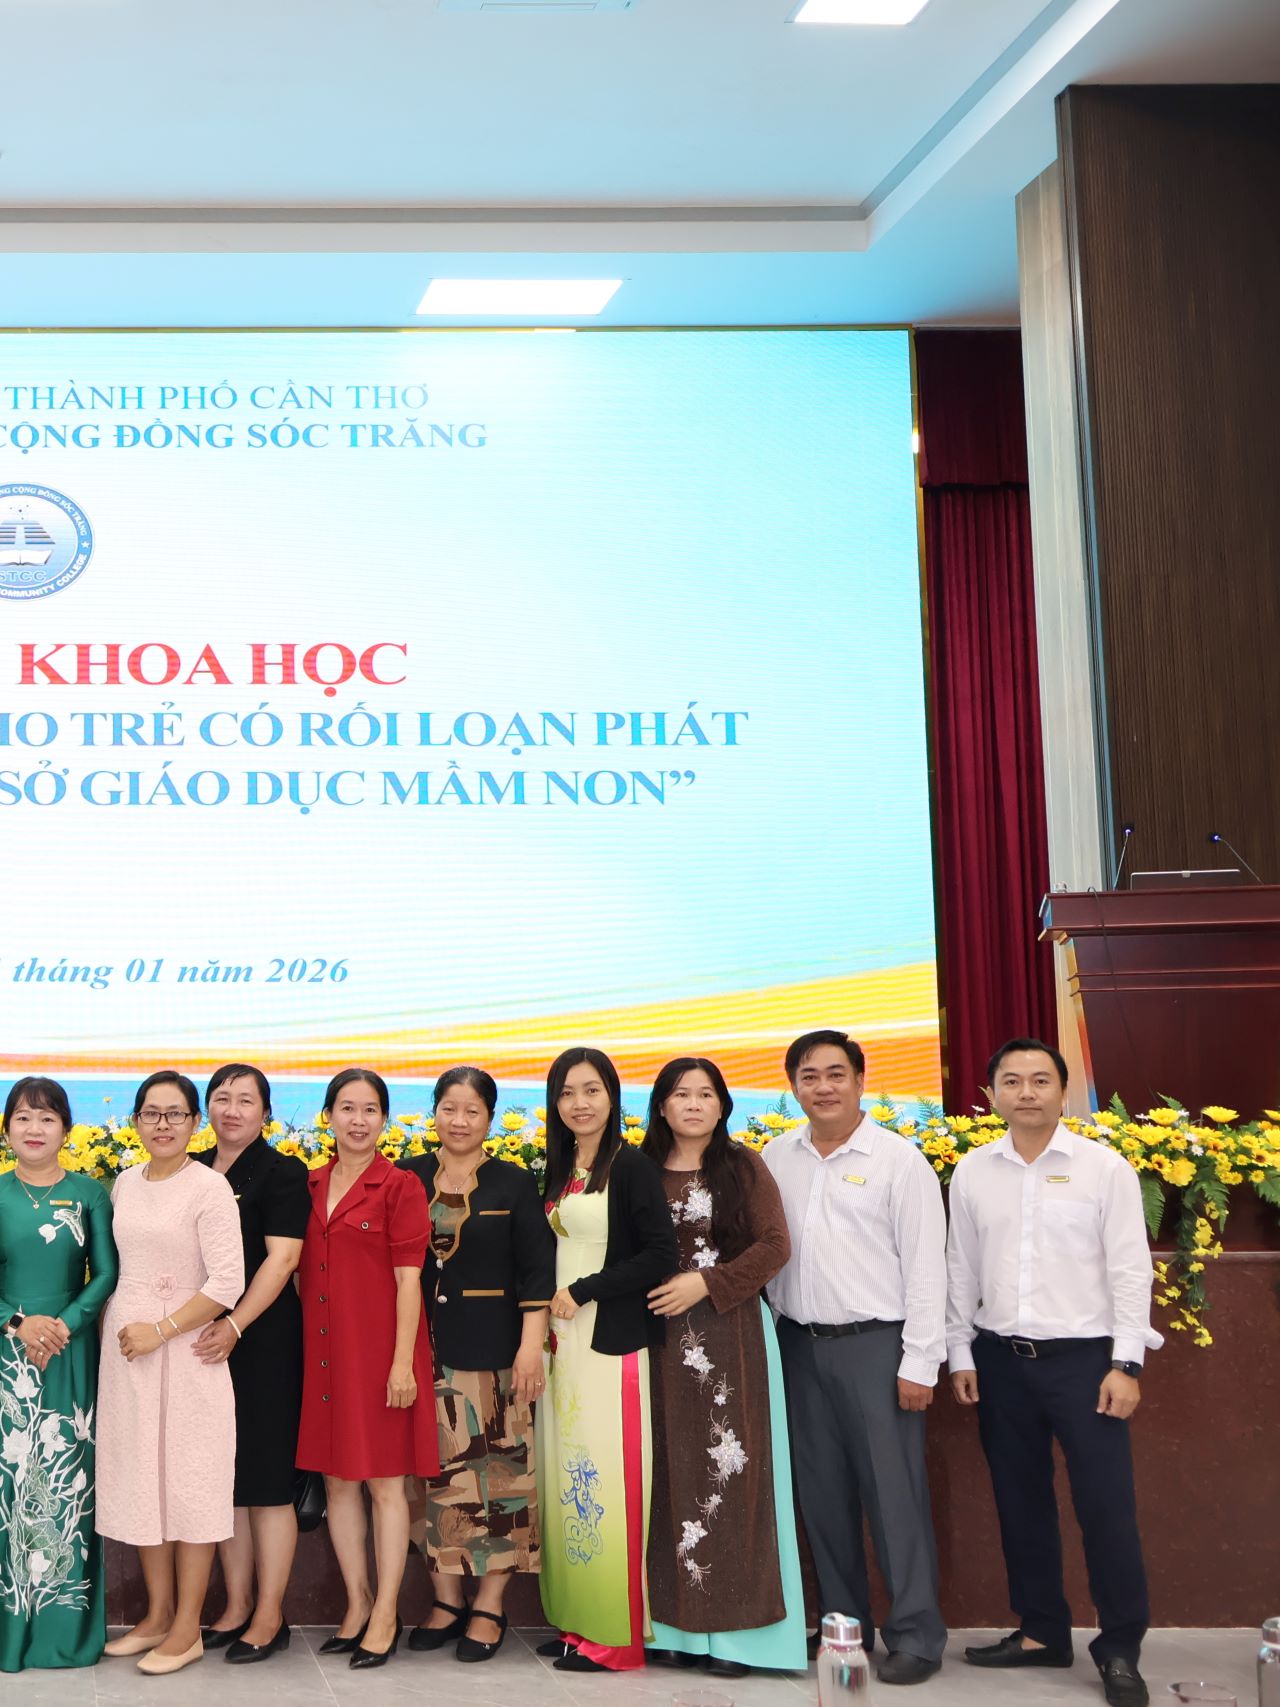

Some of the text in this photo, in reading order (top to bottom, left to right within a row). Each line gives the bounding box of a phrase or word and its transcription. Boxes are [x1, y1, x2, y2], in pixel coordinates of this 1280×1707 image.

[4, 379, 144, 410] THÀNH
[159, 379, 238, 410] PHỐ
[250, 379, 333, 409] CẦN
[346, 383, 429, 409] THƠ
[113, 418, 237, 448] ĐỒNG
[247, 417, 329, 448] SÓC
[338, 418, 487, 448] TRĂNG
[55, 553, 88, 587] COLLEGE
[16, 643, 234, 686] KHOA
[246, 642, 408, 698] HỌC
[70, 701, 185, 746] TRẺ
[198, 702, 284, 747] CÓ
[296, 701, 402, 747] RỐI
[416, 711, 578, 756] LOẠN
[592, 701, 749, 747] PHÁT
[80, 760, 230, 807] GIÁO
[241, 770, 365, 816] DỤC
[379, 760, 529, 805] MẦM
[12, 957, 114, 990] tháng
[125, 958, 164, 983] 01
[177, 959, 253, 983] năm
[265, 958, 349, 984] 2026
